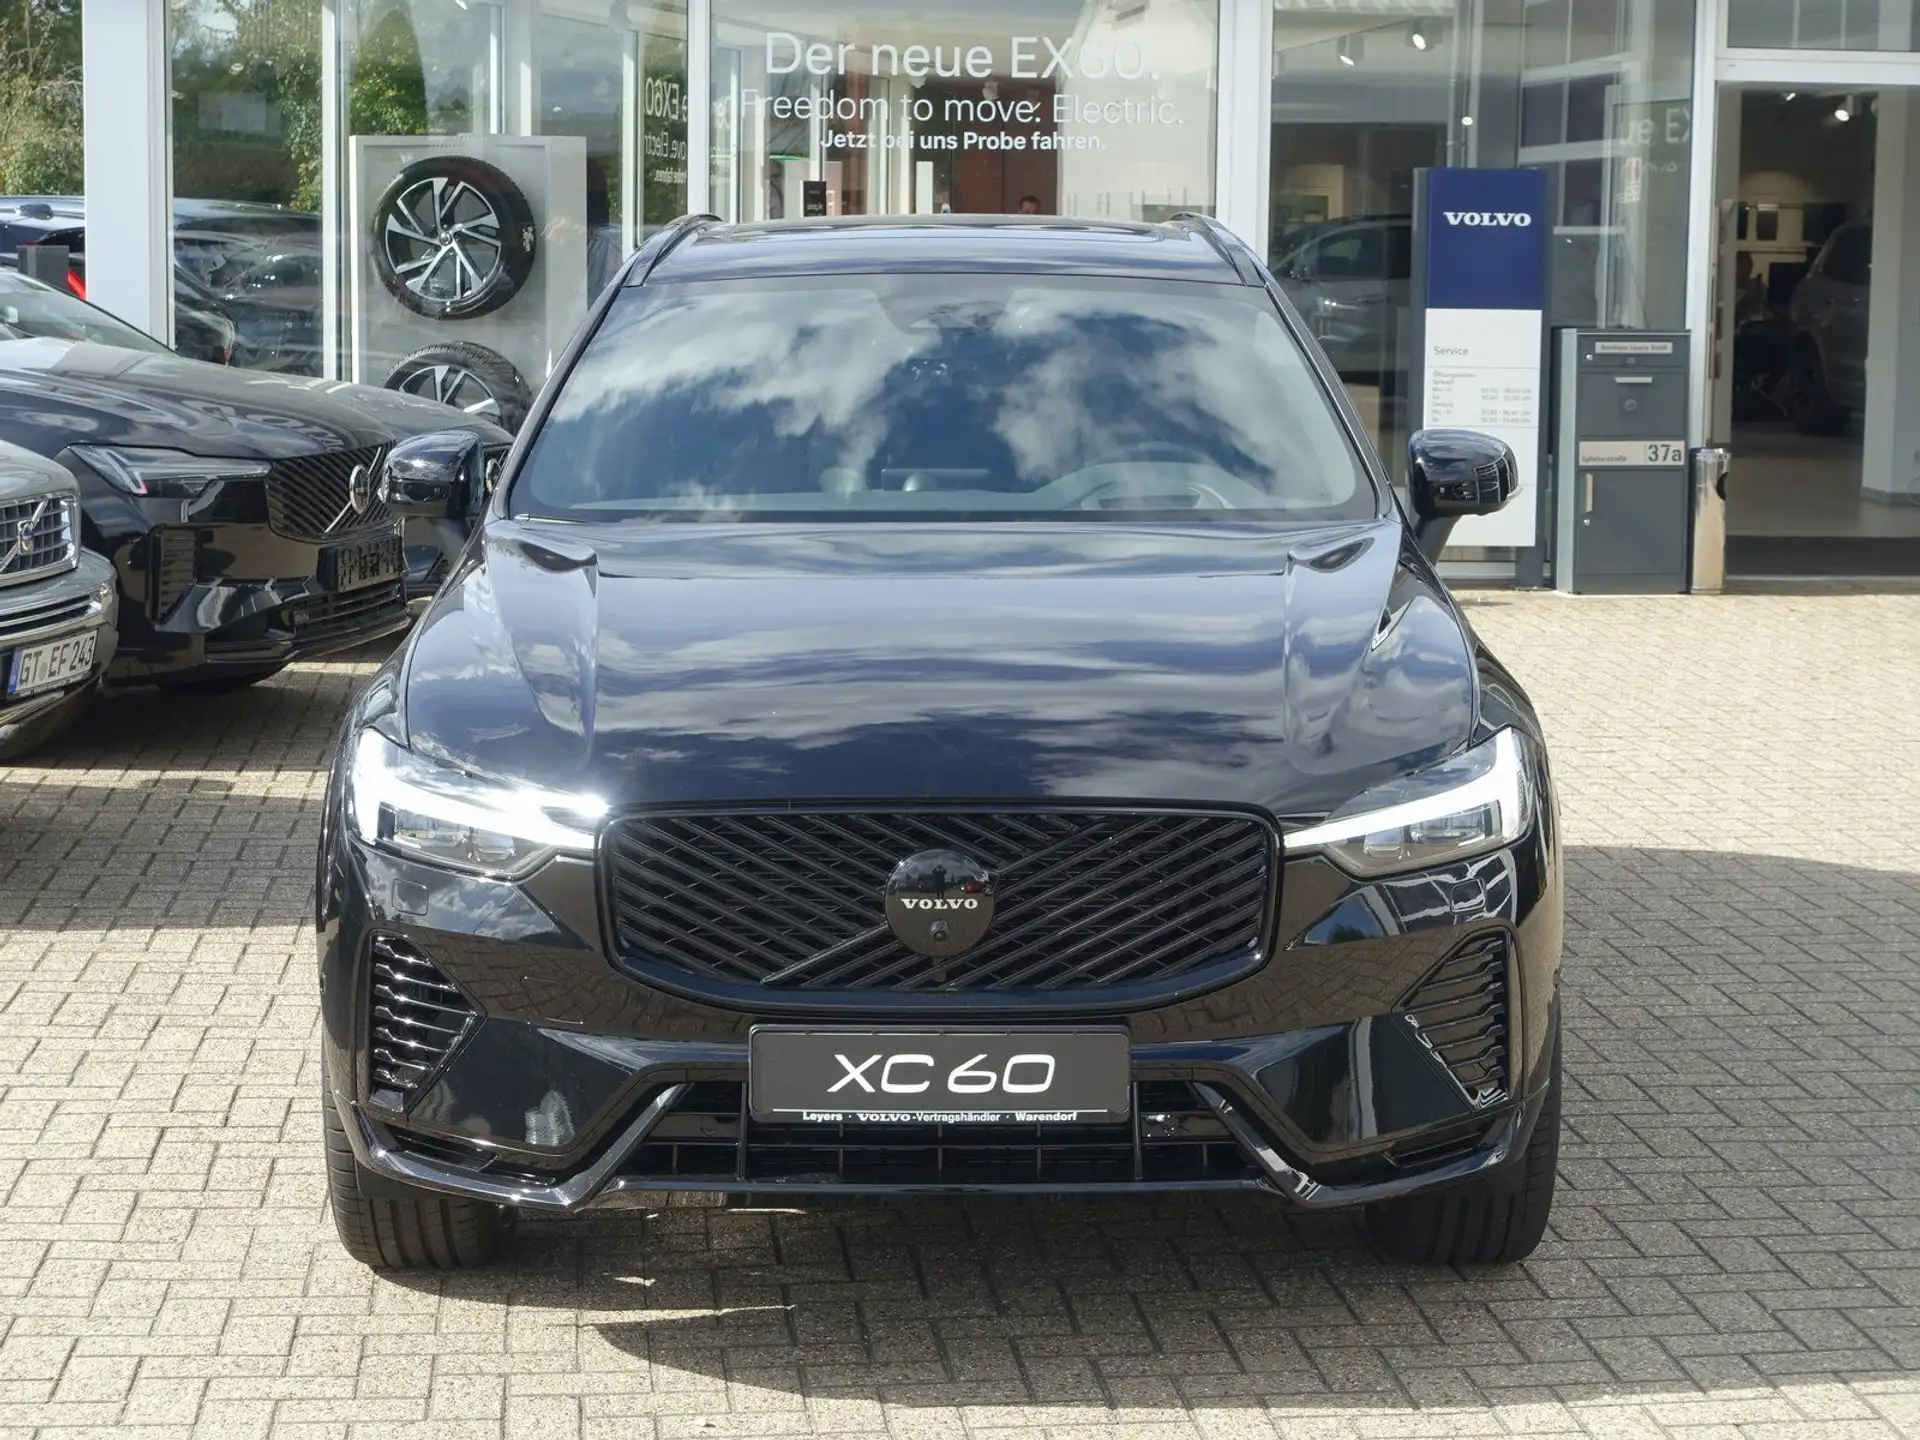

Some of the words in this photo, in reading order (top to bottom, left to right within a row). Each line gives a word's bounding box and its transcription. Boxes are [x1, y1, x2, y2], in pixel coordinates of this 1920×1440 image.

[766, 32, 855, 75] Der
[872, 44, 993, 78] neue
[1011, 36, 1159, 80] EX60.
[741, 88, 889, 120] Freedom
[900, 94, 934, 122] to
[944, 98, 1041, 123] move.
[1053, 94, 1183, 124] Electric.
[820, 130, 876, 149] Jetzt
[885, 131, 914, 149] bei
[920, 134, 958, 150] uns
[963, 131, 1027, 150] Probe
[1031, 131, 1107, 150] fahren.
[1443, 212, 1532, 227] VOLVO
[1434, 345, 1469, 356] Service
[1648, 444, 1683, 462] 37a
[20, 650, 43, 685] GT
[48, 643, 70, 678] EF
[69, 635, 95, 671] 243
[901, 898, 978, 910] VOLVO
[802, 1111, 843, 1122] Leyers
[1015, 1111, 1078, 1121] Warendorf
